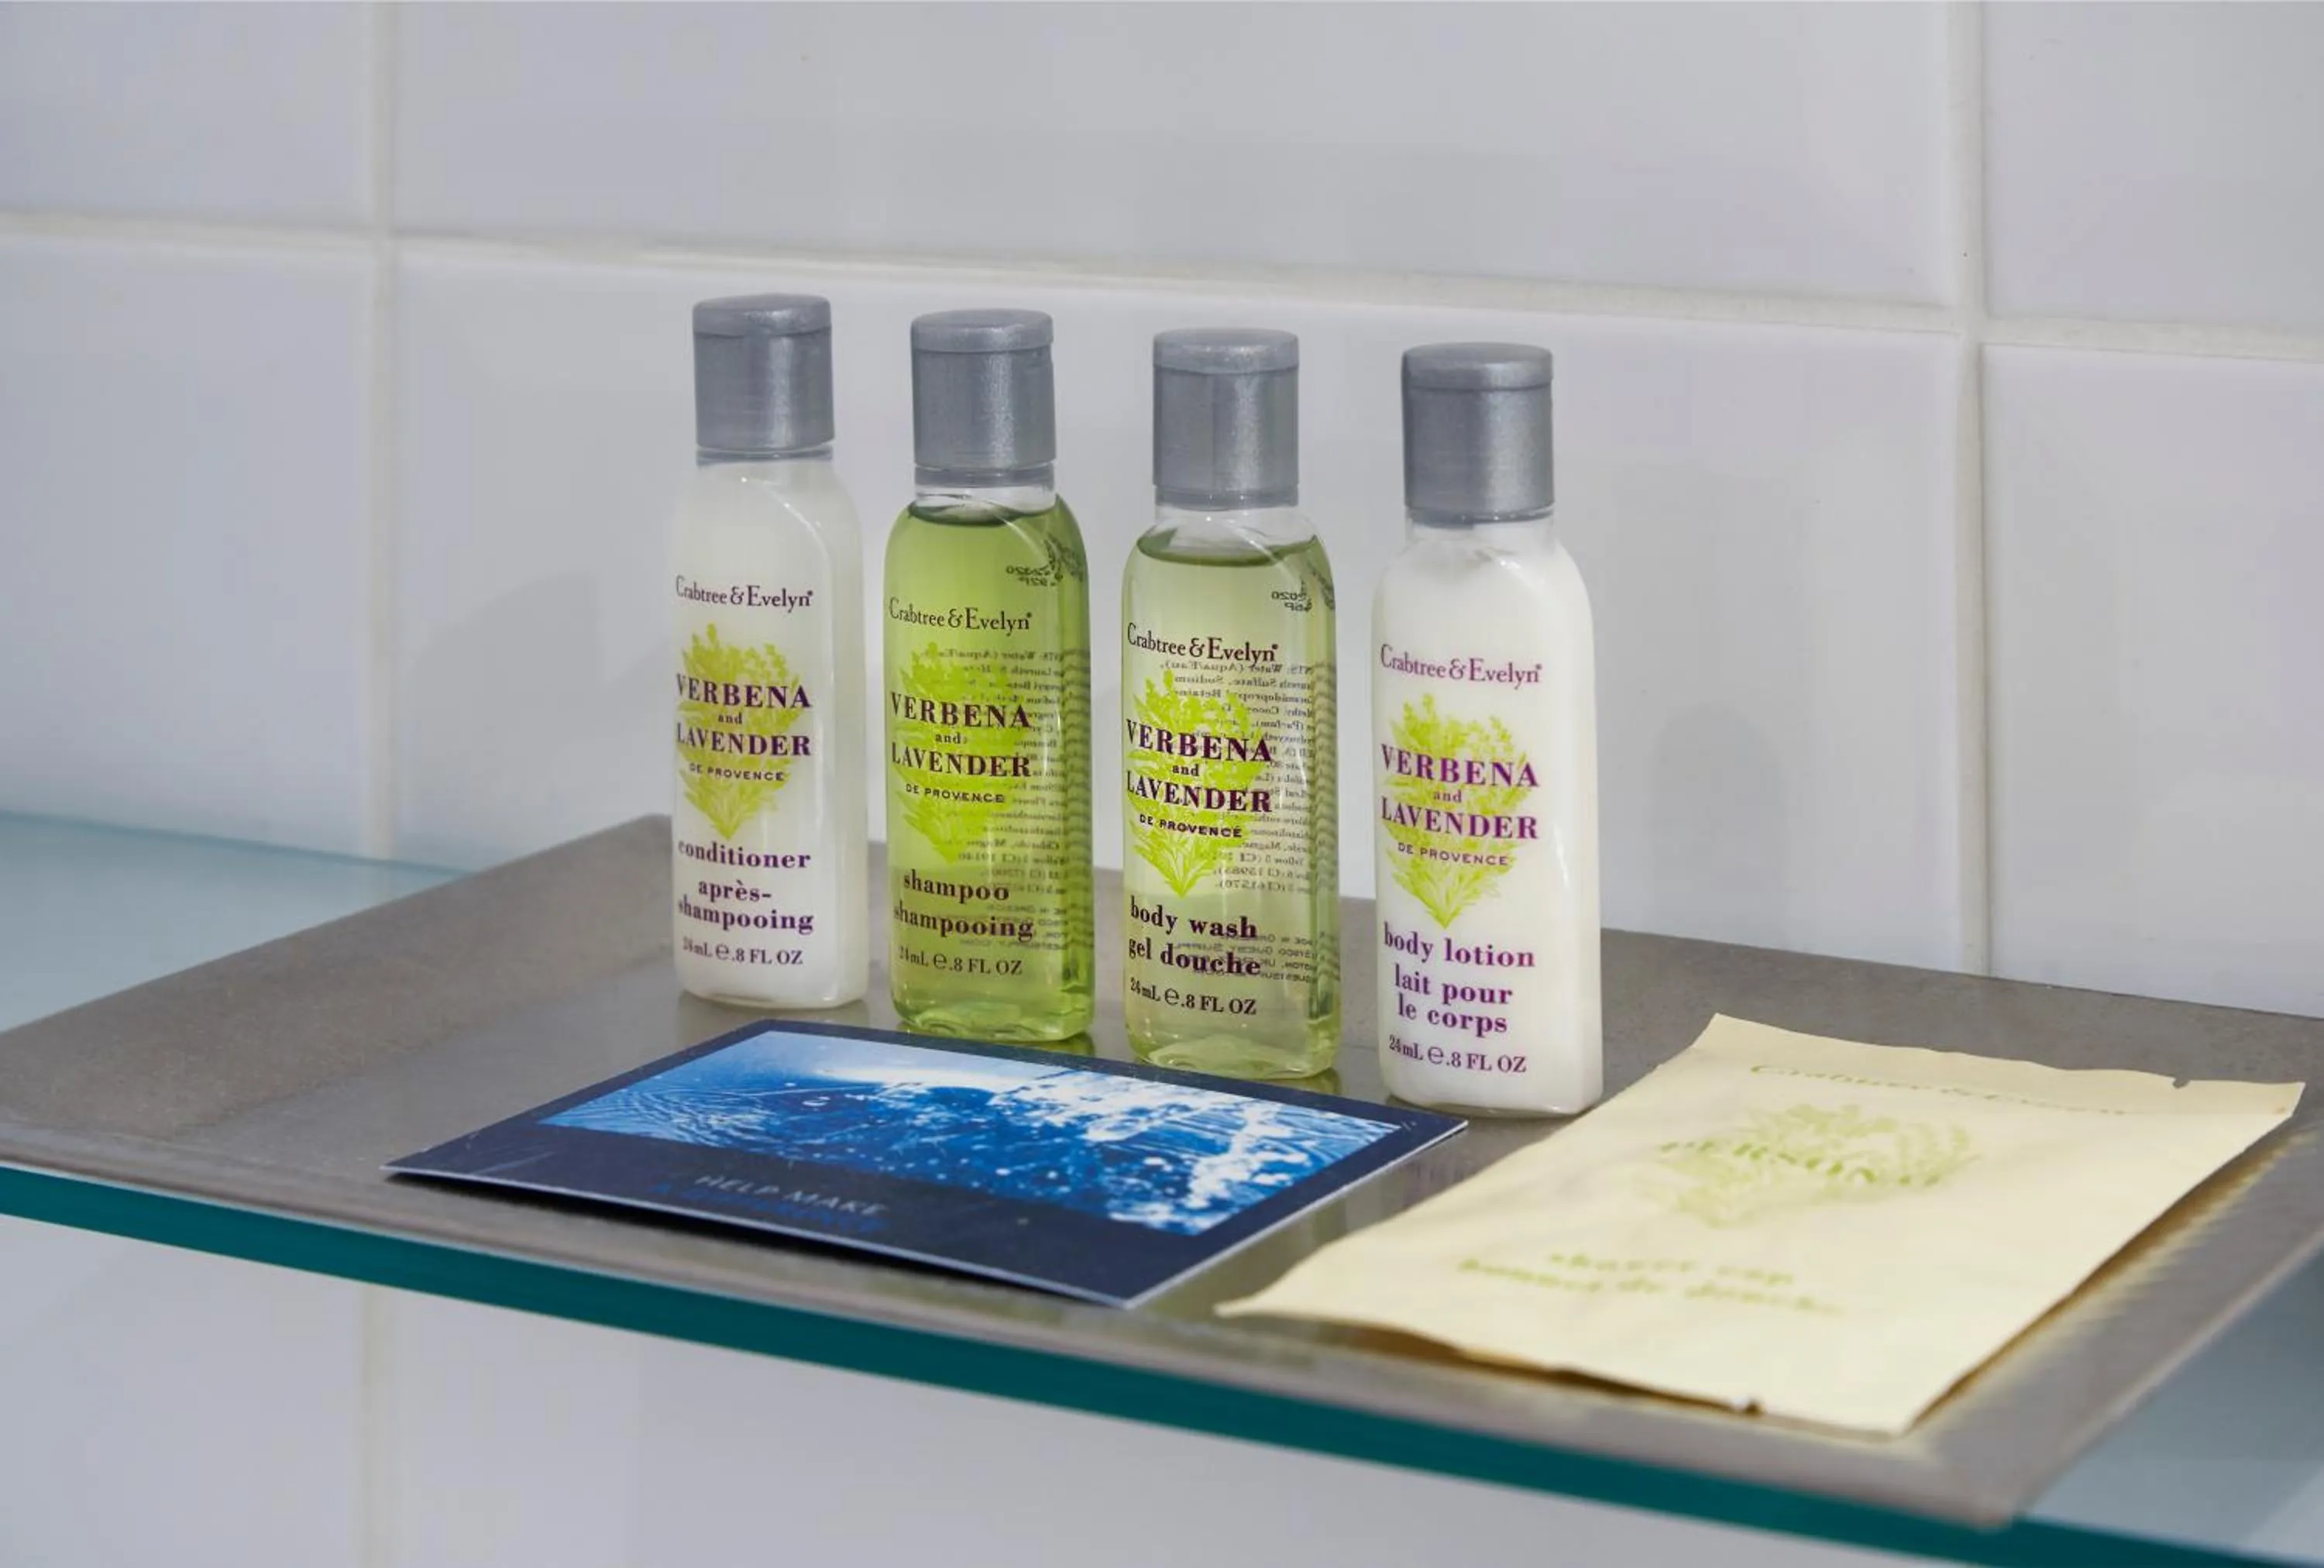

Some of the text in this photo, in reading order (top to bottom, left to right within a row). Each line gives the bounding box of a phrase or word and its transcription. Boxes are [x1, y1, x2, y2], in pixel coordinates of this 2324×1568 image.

[676, 575, 727, 604] Crabtree
[730, 586, 744, 605] &
[889, 597, 944, 627] Crabtree
[948, 608, 962, 628] &
[1127, 622, 1186, 655] Crabtree
[1189, 637, 1205, 658] &
[1380, 644, 1446, 679] Crabtree
[1449, 658, 1466, 680] &
[677, 673, 813, 709] VERBENA
[718, 712, 743, 725] and
[891, 692, 1032, 728] VERBENA
[677, 723, 811, 756] LAVENDER
[935, 732, 961, 744] and
[1126, 719, 1273, 762] VERBENA
[708, 766, 785, 781] PROVENCE
[892, 742, 1032, 777] LAVENDER
[1172, 763, 1199, 776] and
[1381, 743, 1540, 788] VERBENA
[906, 783, 1006, 803] DE PROVENCE
[1127, 771, 1273, 813] LAVENDER
[1433, 789, 1463, 803] and
[1140, 813, 1153, 827] DE
[1160, 819, 1242, 838] PROVENCE
[1381, 796, 1539, 840] LAVENDER
[679, 841, 811, 868] conditioner
[1397, 842, 1508, 866] DE PROVENCE
[698, 879, 772, 903] après-
[904, 869, 1009, 904] shampoo
[679, 894, 814, 935] shampooing
[894, 900, 1035, 943] shampooing
[1131, 895, 1258, 939] body wash
[750, 949, 772, 964] FL
[777, 950, 803, 965] OZ
[1129, 937, 1151, 960] gel
[1160, 942, 1262, 975] douche
[1384, 921, 1535, 968] body lotion
[968, 958, 992, 975] FL
[995, 960, 1023, 976] OZ
[1394, 964, 1513, 1006] lait pour
[1200, 995, 1224, 1013] FL
[1229, 998, 1257, 1015] OZ
[1397, 993, 1508, 1037] le corps
[1389, 1034, 1423, 1061] 24mL
[1466, 1053, 1492, 1071] FL
[1497, 1055, 1527, 1073] OZ
